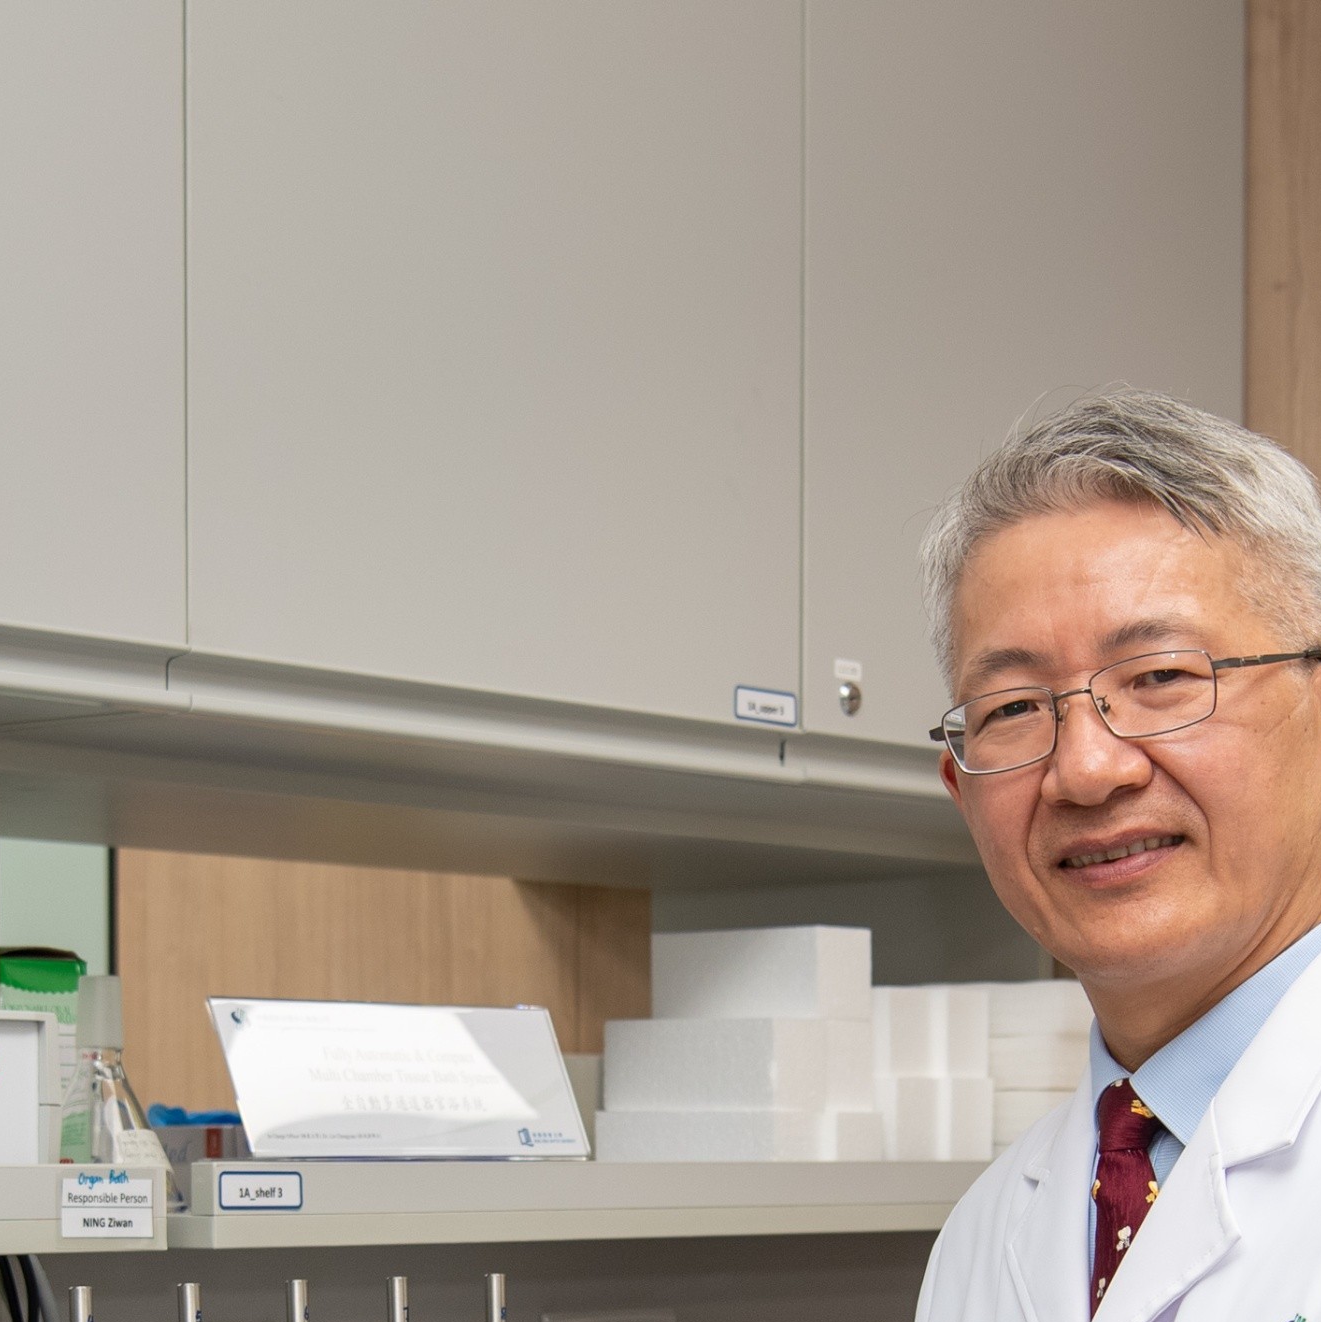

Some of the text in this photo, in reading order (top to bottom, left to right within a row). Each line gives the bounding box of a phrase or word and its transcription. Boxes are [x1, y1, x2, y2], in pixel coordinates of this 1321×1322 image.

[68, 1192, 148, 1206] Responsible Person
[239, 1187, 283, 1201] 1A_shelf 3
[82, 1218, 133, 1228] NING Ziwan
